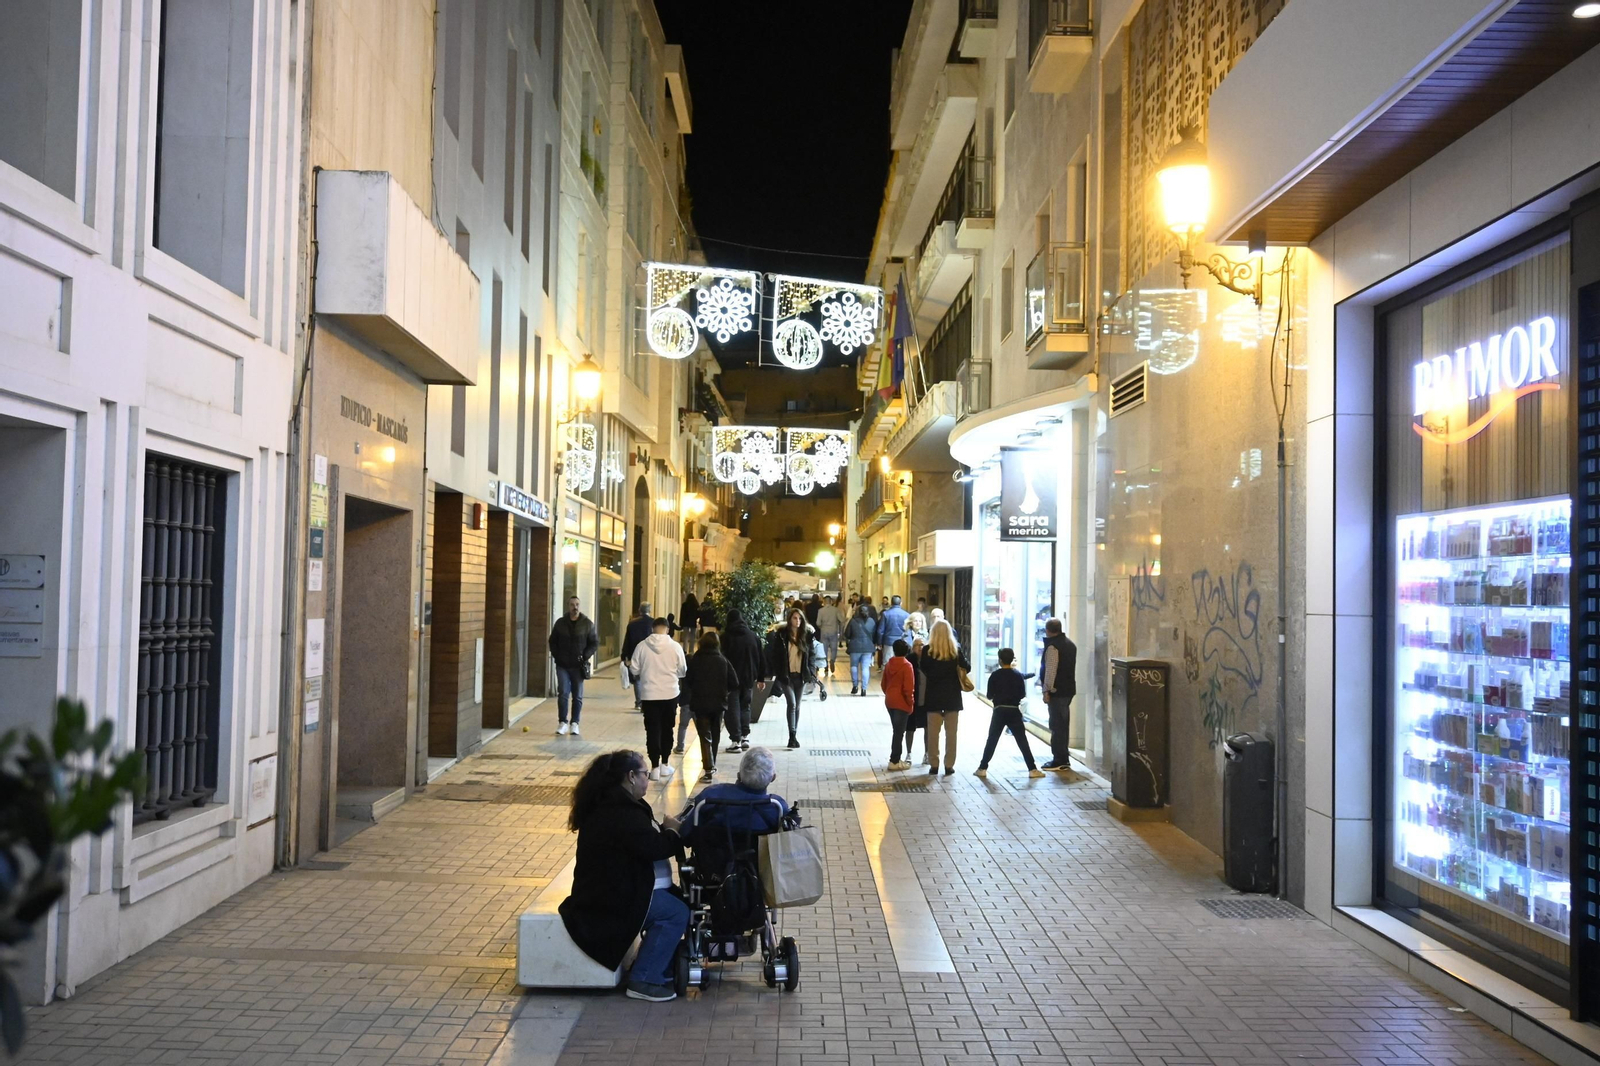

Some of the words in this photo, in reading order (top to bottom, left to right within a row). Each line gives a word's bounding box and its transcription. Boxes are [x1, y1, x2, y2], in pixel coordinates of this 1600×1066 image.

[1414, 317, 1559, 415] PRIMOR
[340, 395, 371, 427] EDIFICIO
[1008, 515, 1049, 526] sara
[1008, 526, 1049, 535] merino
